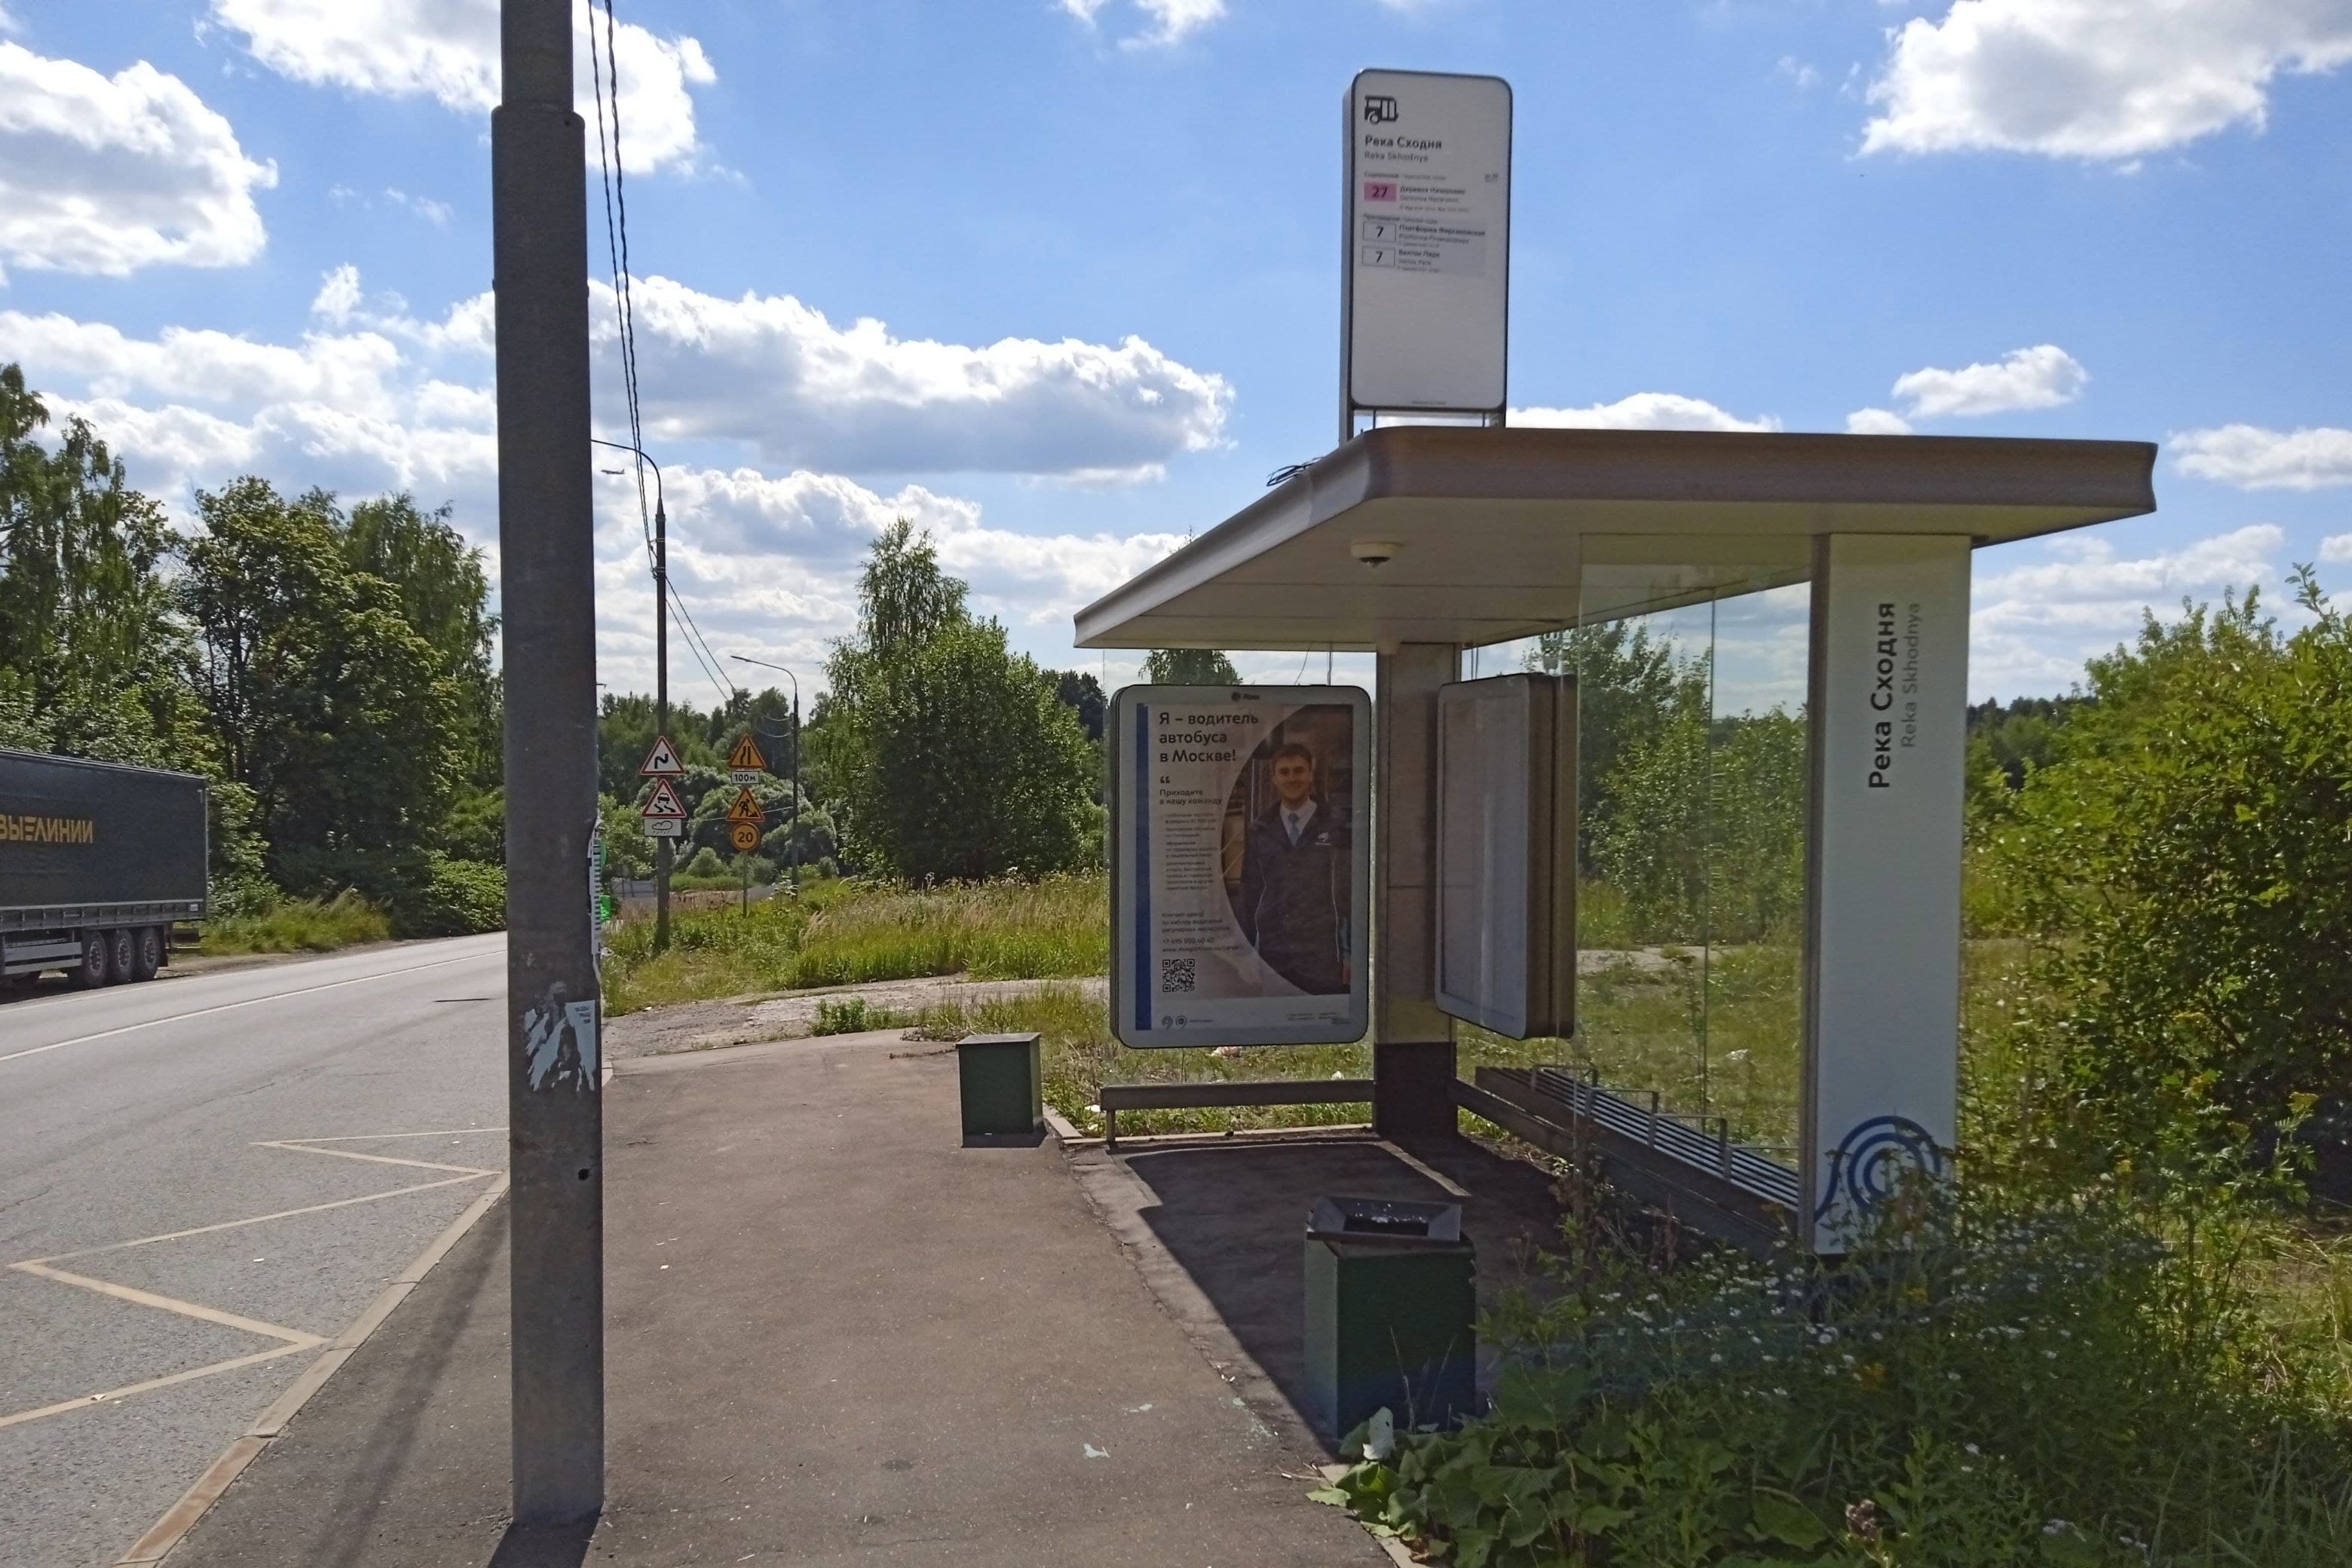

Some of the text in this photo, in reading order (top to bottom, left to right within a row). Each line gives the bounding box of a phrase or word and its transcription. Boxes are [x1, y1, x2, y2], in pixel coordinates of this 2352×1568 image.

[1364, 134, 1442, 151] Река Сходня
[1371, 185, 1389, 199] 27
[1376, 225, 1384, 238] 7
[1375, 250, 1383, 264] 7
[1900, 603, 1924, 748] Reka Skhodnya
[1869, 603, 1897, 788] Река Сходня
[1159, 712, 1169, 725] Я
[1188, 715, 1259, 726] водитель
[1159, 730, 1227, 746] автобуса
[1160, 749, 1236, 762] в Москве!
[1159, 789, 1204, 797] Приходите
[1188, 798, 1223, 806] команду
[737, 831, 753, 844] 20
